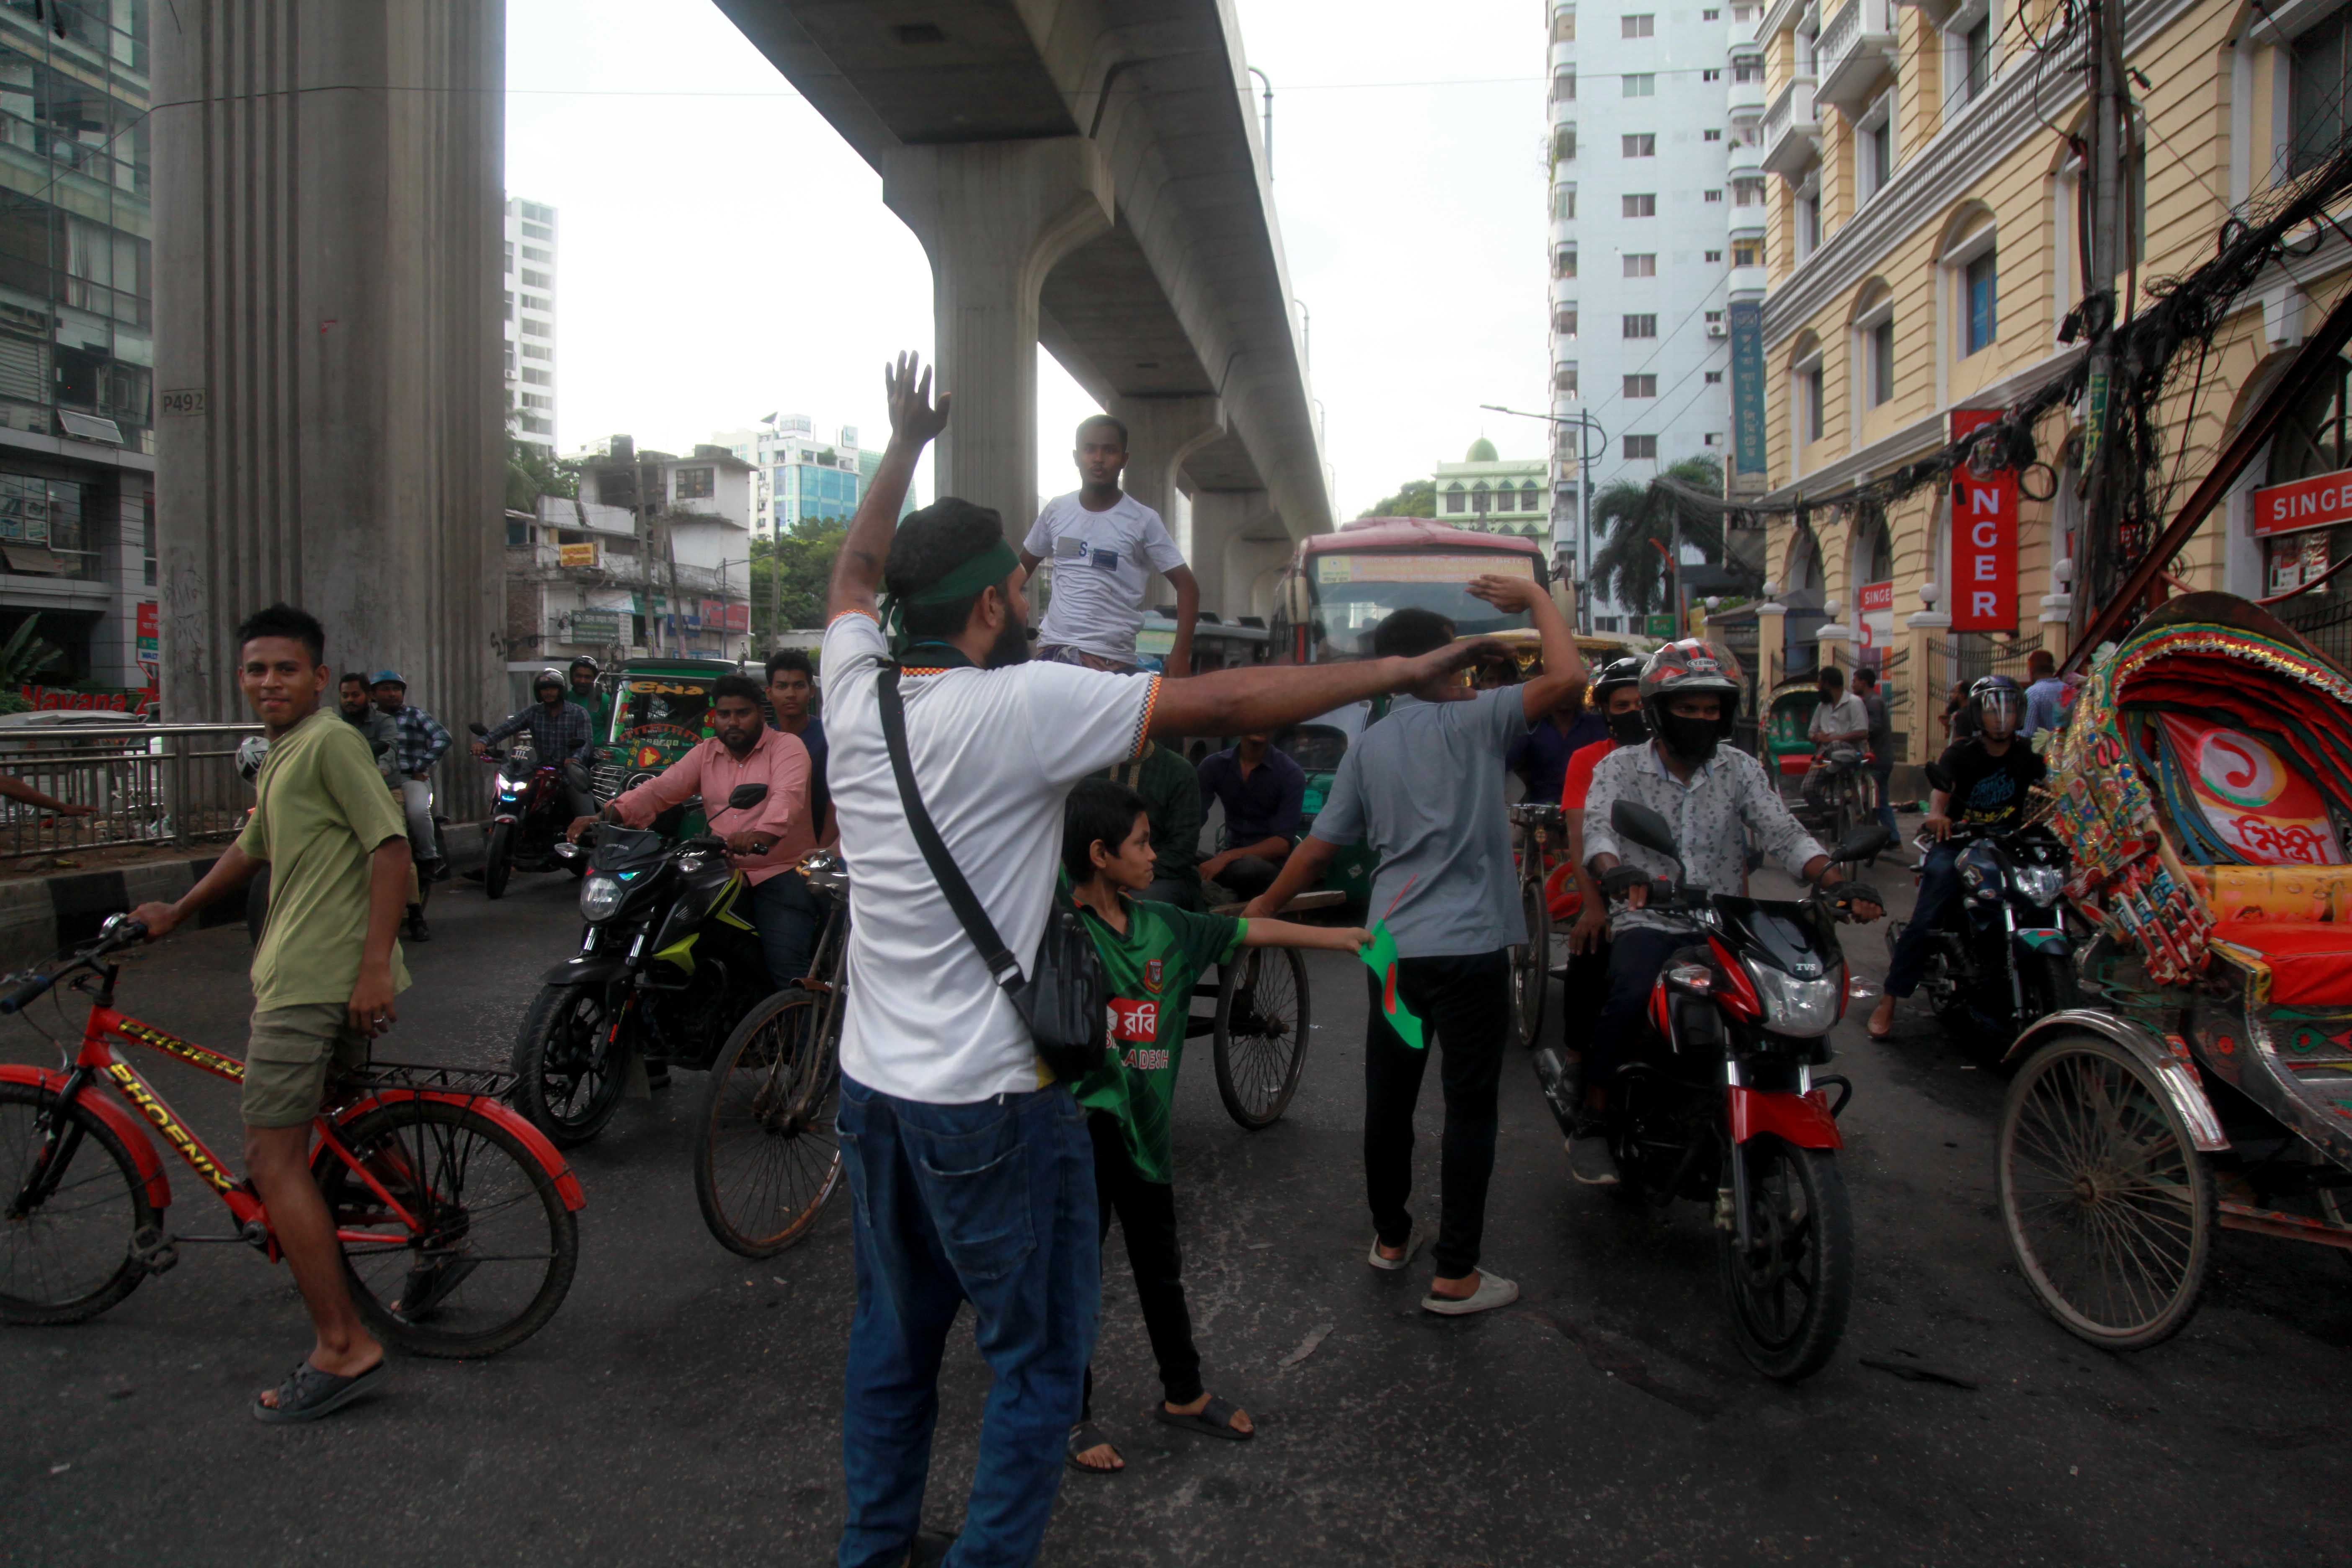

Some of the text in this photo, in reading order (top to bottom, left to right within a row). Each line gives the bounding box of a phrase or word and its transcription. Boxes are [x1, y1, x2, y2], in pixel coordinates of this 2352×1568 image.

[164, 394, 204, 412] P492
[2273, 485, 2352, 521] SINGE
[1971, 423, 1999, 617] NGER
[1078, 541, 1088, 557] S
[1865, 588, 1893, 605] SINGE
[21, 685, 160, 716] Navana Z
[1124, 1003, 1156, 1036] রবি
[119, 1020, 245, 1079] PHOEN
[110, 1063, 232, 1190] PHOENIX
